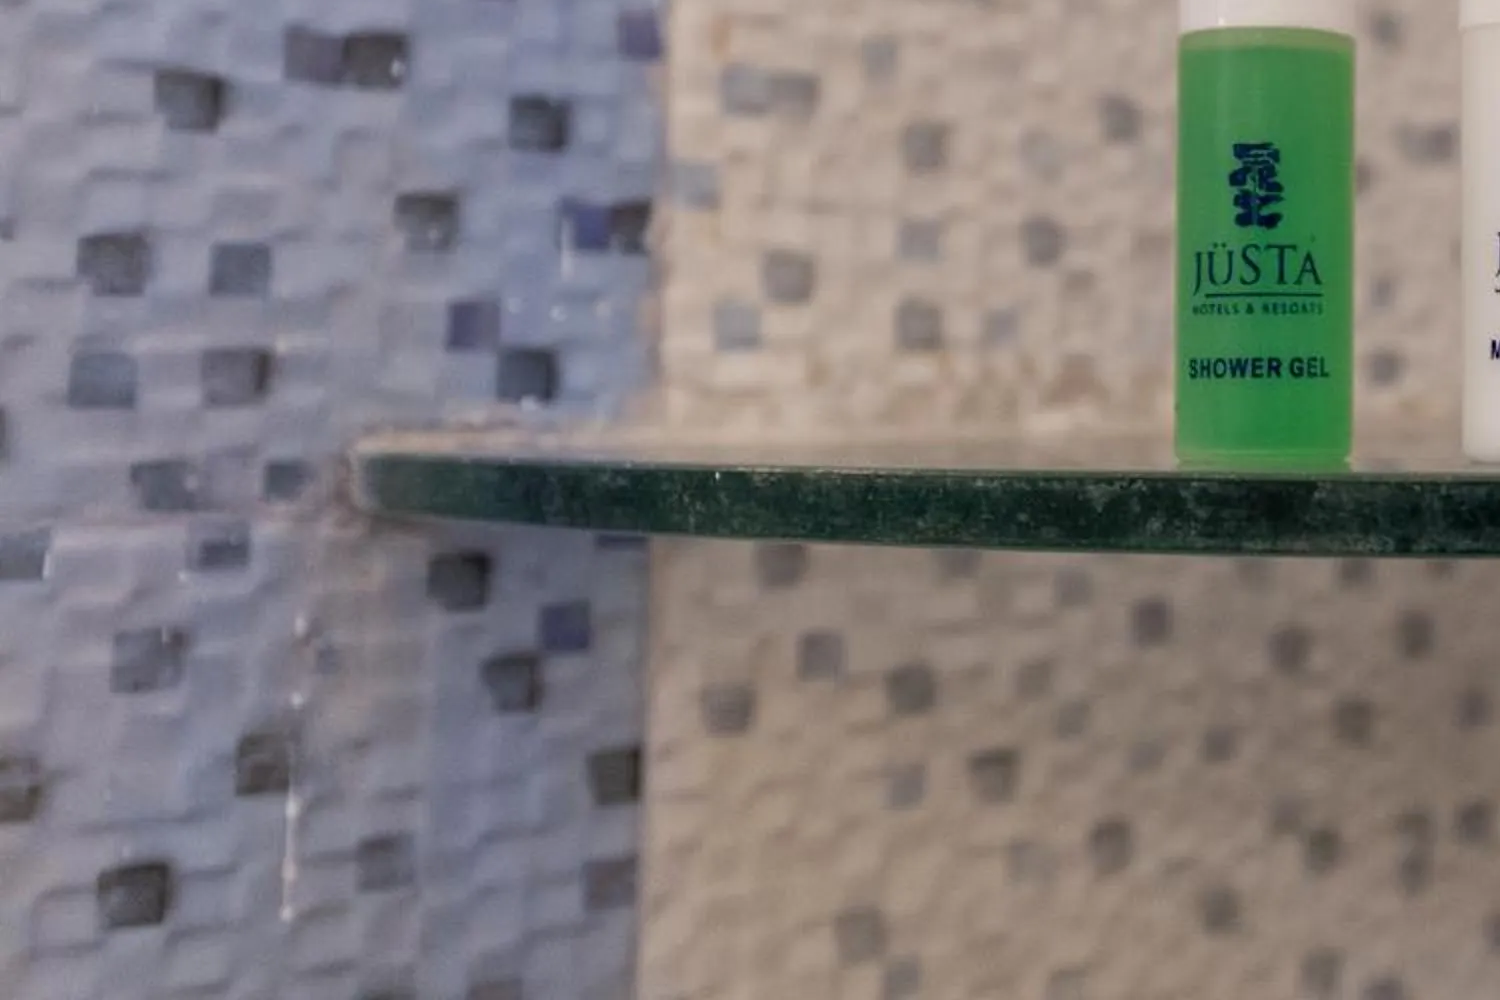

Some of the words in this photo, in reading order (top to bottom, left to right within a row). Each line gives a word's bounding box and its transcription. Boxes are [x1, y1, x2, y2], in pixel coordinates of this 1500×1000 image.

[1193, 243, 1323, 297] JÜSTA
[1192, 302, 1239, 315] HOTELS
[1245, 302, 1254, 315] &
[1262, 302, 1324, 315] RESORTS
[1189, 357, 1282, 380] SHOWER
[1289, 357, 1330, 378] GEL
